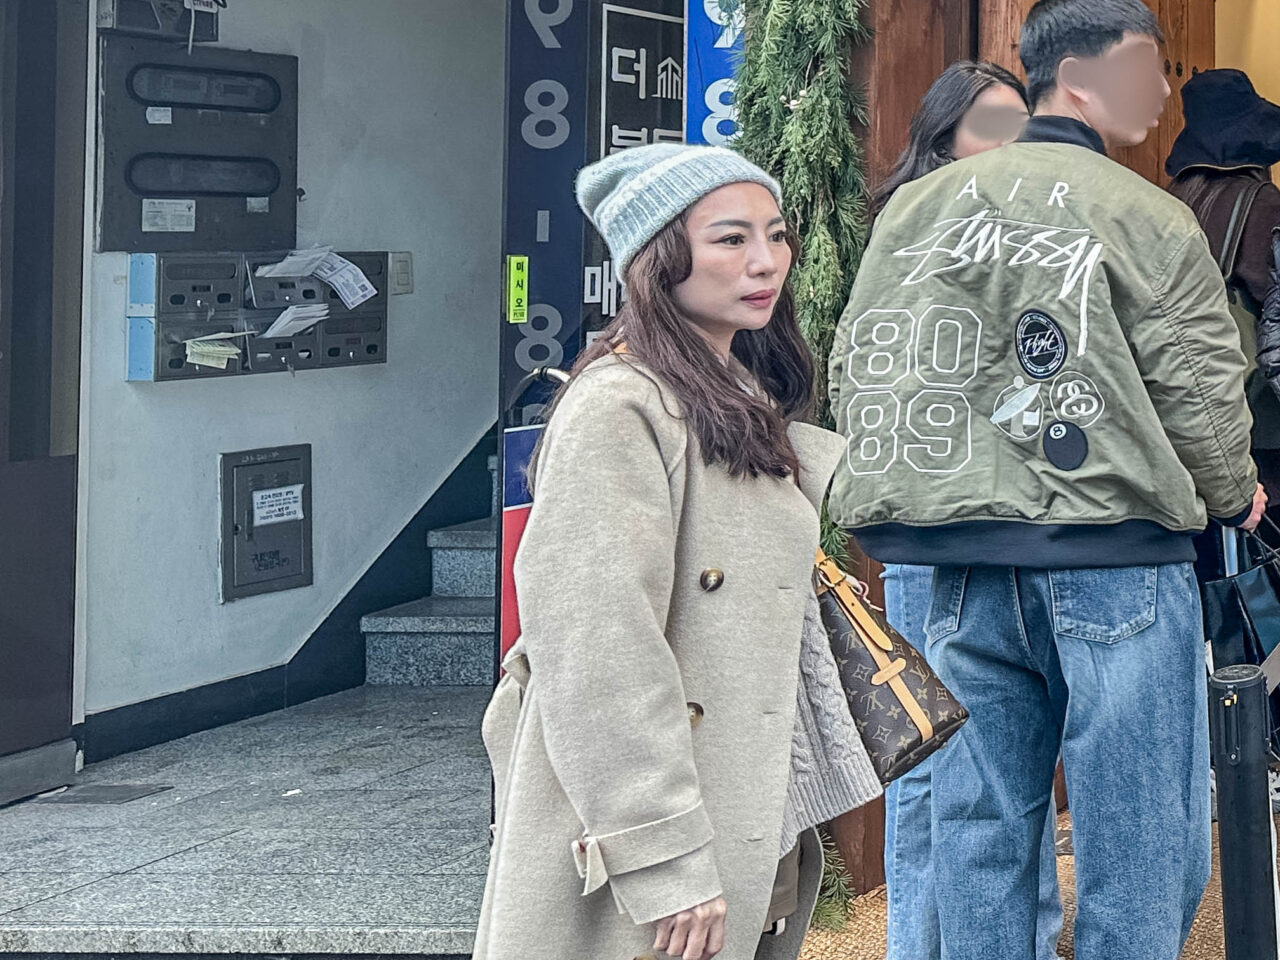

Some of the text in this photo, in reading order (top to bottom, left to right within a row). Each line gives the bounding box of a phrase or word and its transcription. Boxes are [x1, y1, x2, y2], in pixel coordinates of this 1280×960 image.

[611, 46, 646, 100] 더
[956, 174, 1070, 208] AIR
[515, 261, 525, 308] 미시오
[848, 304, 982, 389] 80
[846, 389, 972, 475] 89
[1052, 425, 1065, 438] 8
